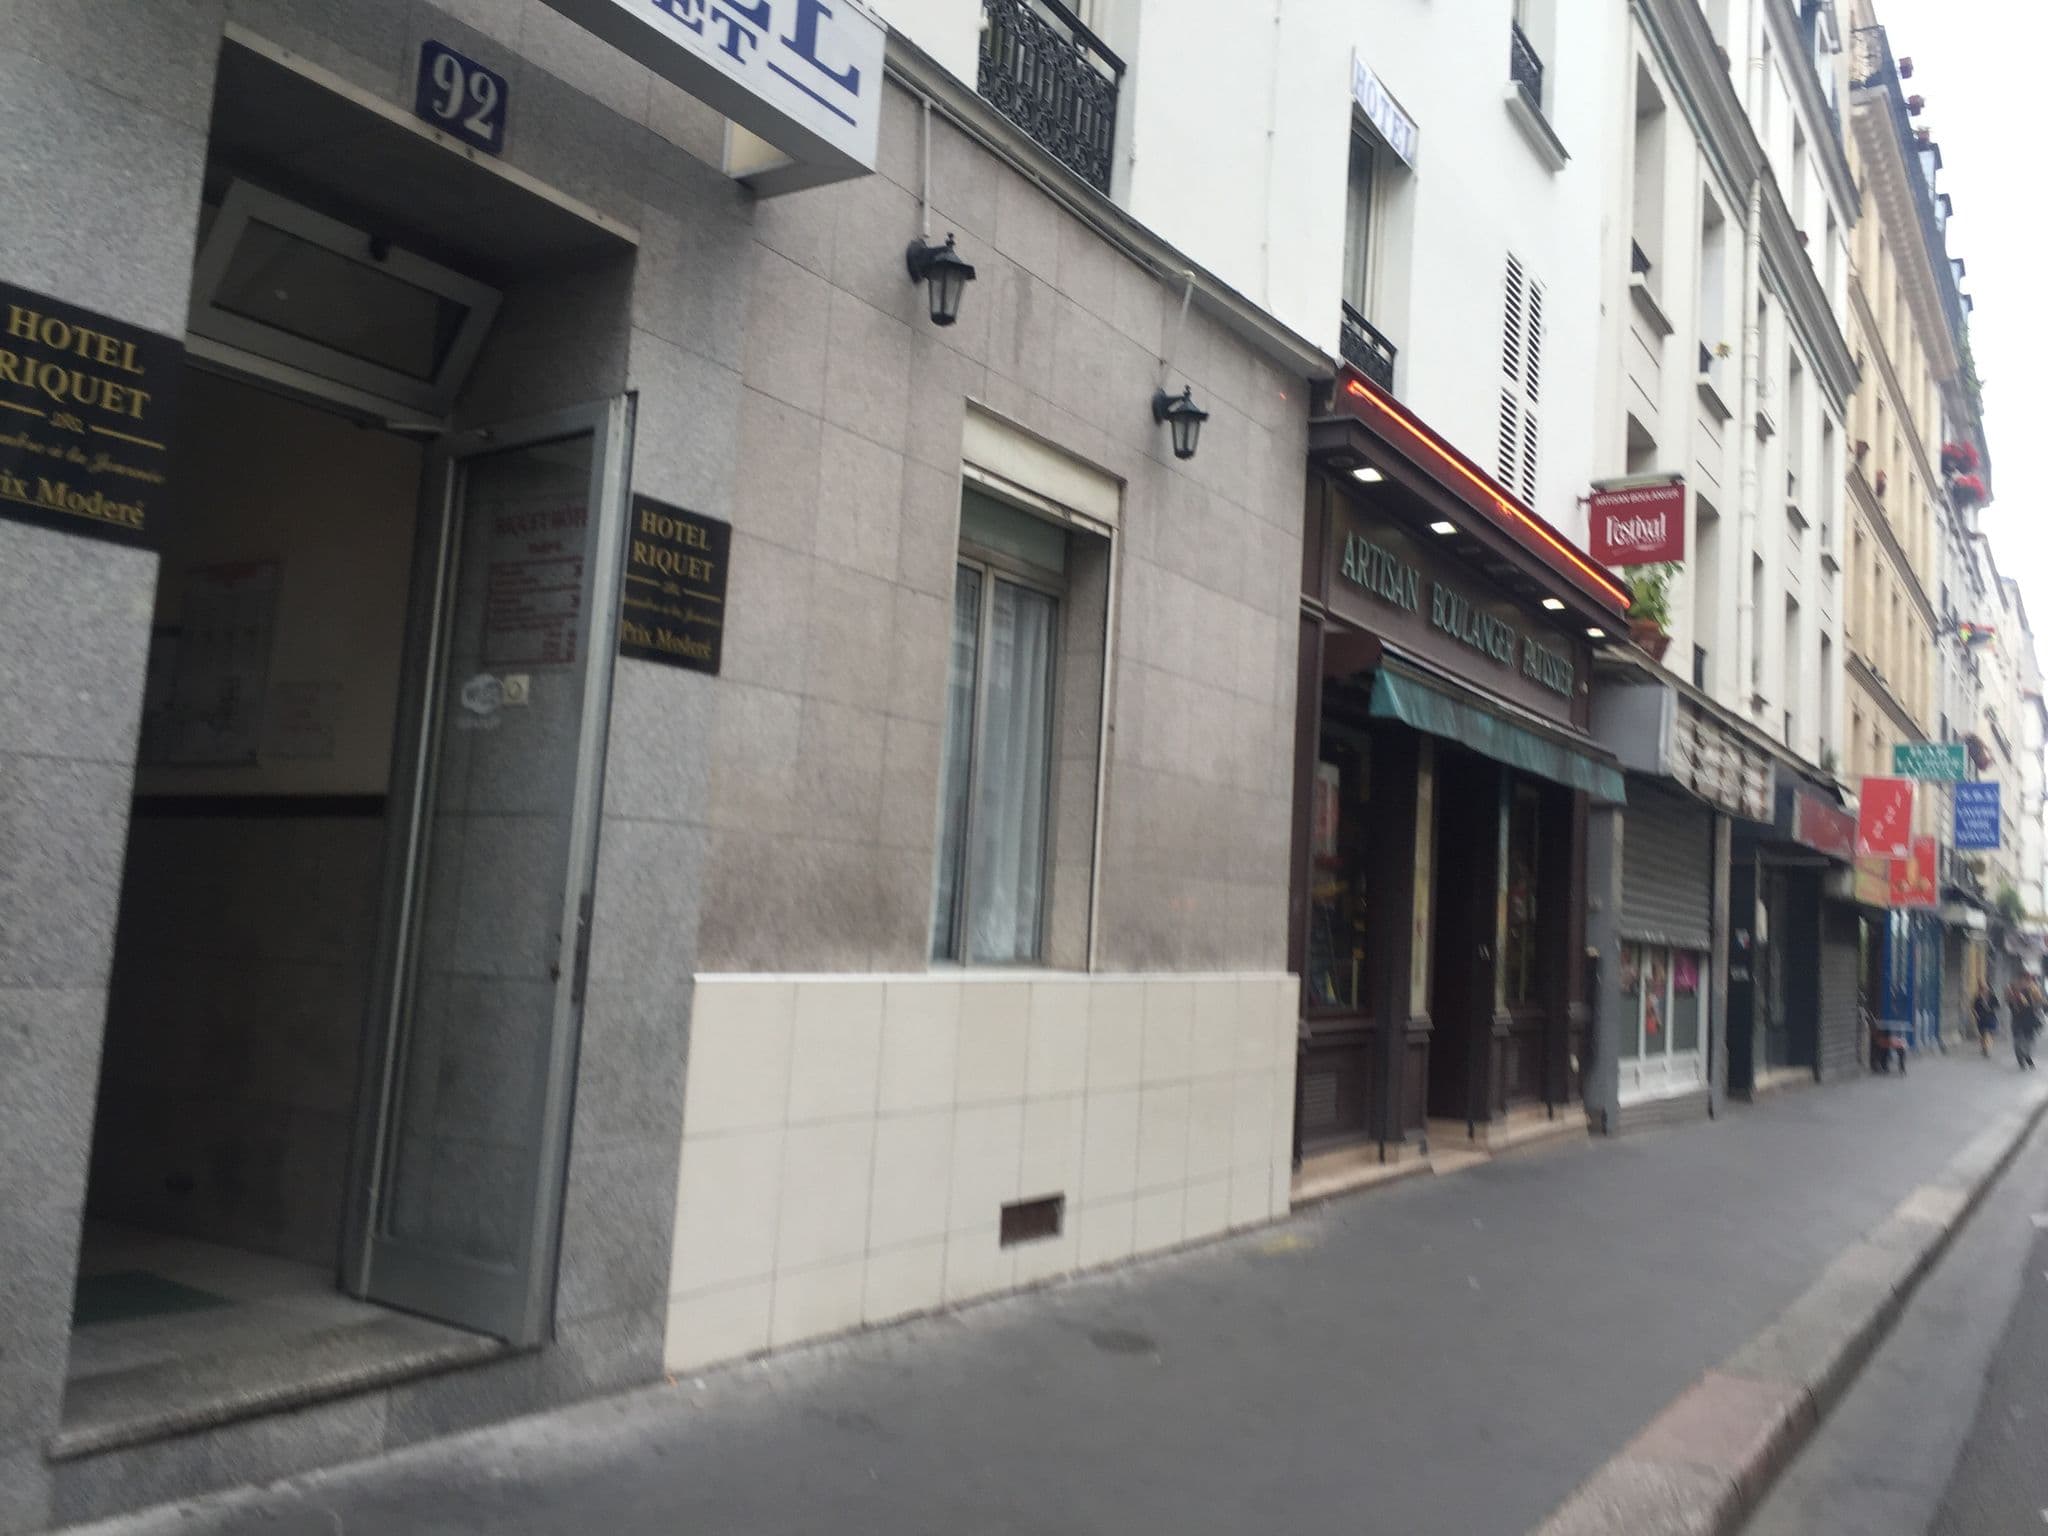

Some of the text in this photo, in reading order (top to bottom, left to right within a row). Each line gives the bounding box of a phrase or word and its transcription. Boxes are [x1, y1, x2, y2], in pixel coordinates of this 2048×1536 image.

[433, 53, 498, 140] 92
[1355, 60, 1415, 167] HOTEL
[7, 304, 145, 375] HOTEL
[0, 349, 152, 420] RIQUET
[633, 539, 714, 584] RIQUET
[641, 509, 712, 551] HOTEL
[1341, 530, 1420, 614] ARTISAN
[1432, 581, 1515, 668] BOULANGER
